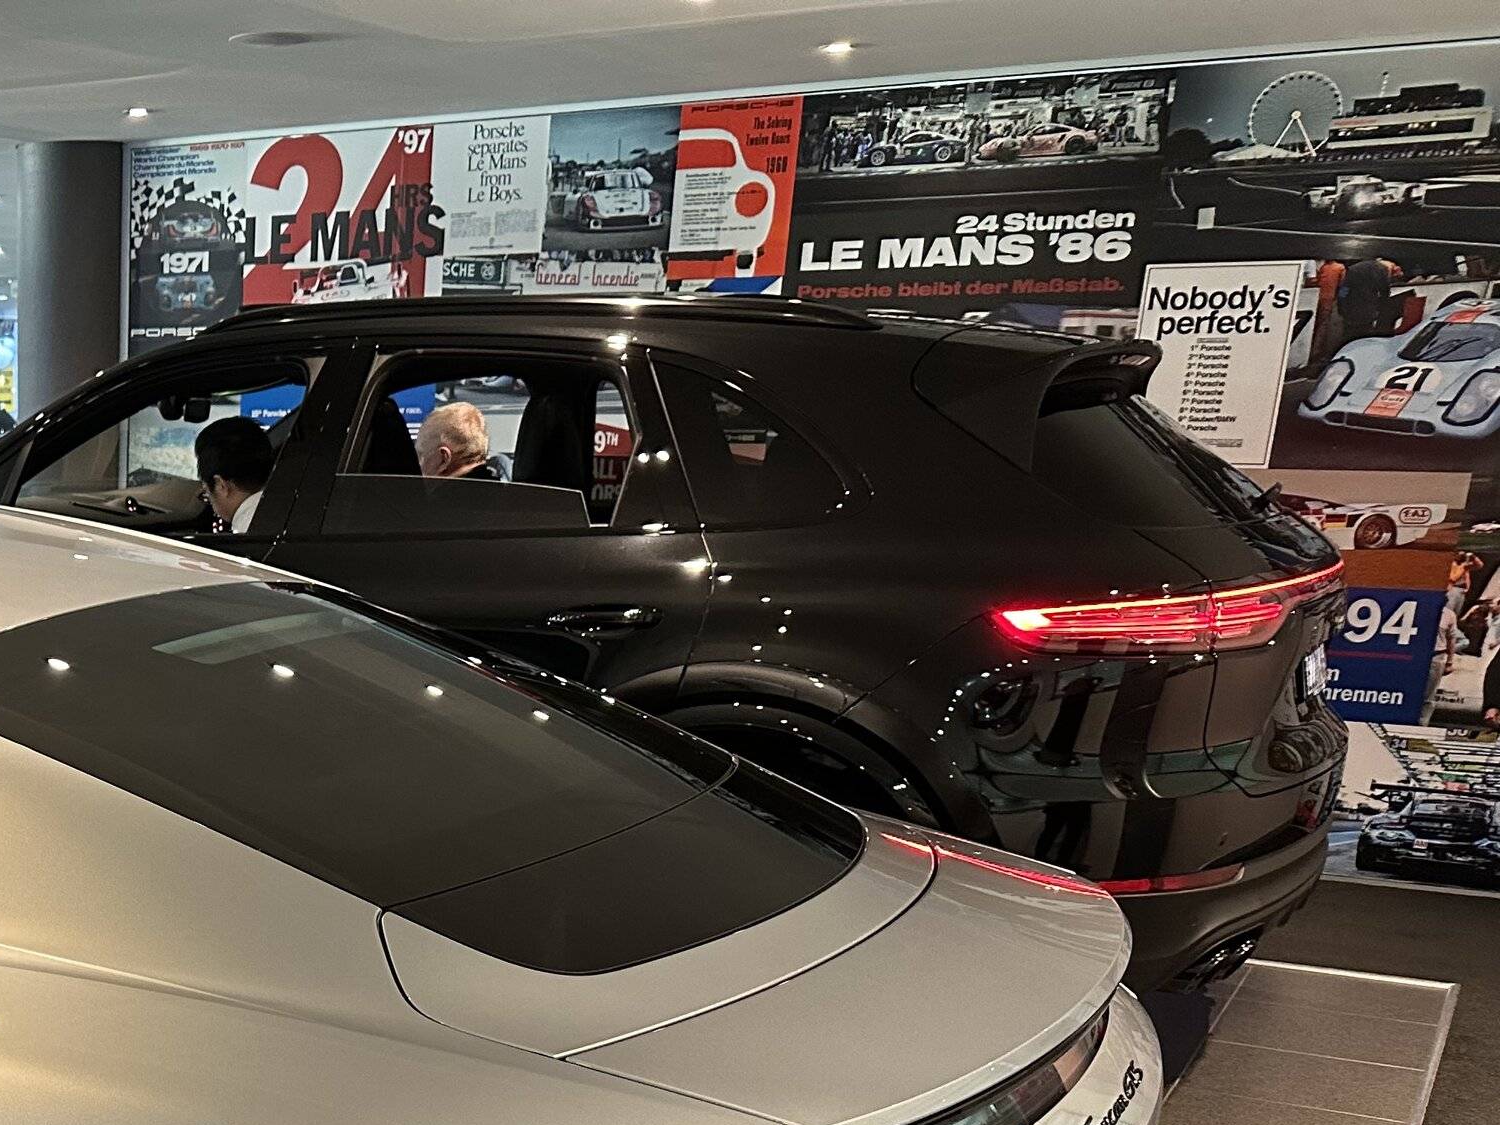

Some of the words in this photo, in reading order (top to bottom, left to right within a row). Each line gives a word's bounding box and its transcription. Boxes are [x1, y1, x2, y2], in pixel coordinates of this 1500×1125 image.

[691, 100, 794, 113] PORSCHE
[474, 121, 525, 140] Porsche
[754, 117, 765, 129] The
[158, 153, 200, 163] Champion
[468, 140, 528, 157] separates
[468, 155, 485, 172] Le
[489, 153, 527, 170] Mans
[766, 156, 788, 174] 1960
[480, 170, 512, 187] from
[390, 182, 434, 208] HRS
[468, 187, 485, 203] Le
[489, 185, 523, 204] Boys.
[955, 214, 999, 234] 24
[1002, 209, 1136, 232] Stunden
[243, 213, 299, 265] LE
[310, 204, 446, 263] MANS
[800, 239, 864, 271] LE
[877, 233, 1035, 269] MANS
[1048, 231, 1132, 263] '86
[160, 251, 210, 274] 1971
[797, 281, 892, 300] Porsche
[898, 280, 962, 298] bleibt
[966, 280, 1009, 296] der
[1148, 284, 1291, 315] Nobody's
[1156, 310, 1271, 341] perfect.
[1385, 366, 1434, 391] 21
[1343, 598, 1418, 645] 94
